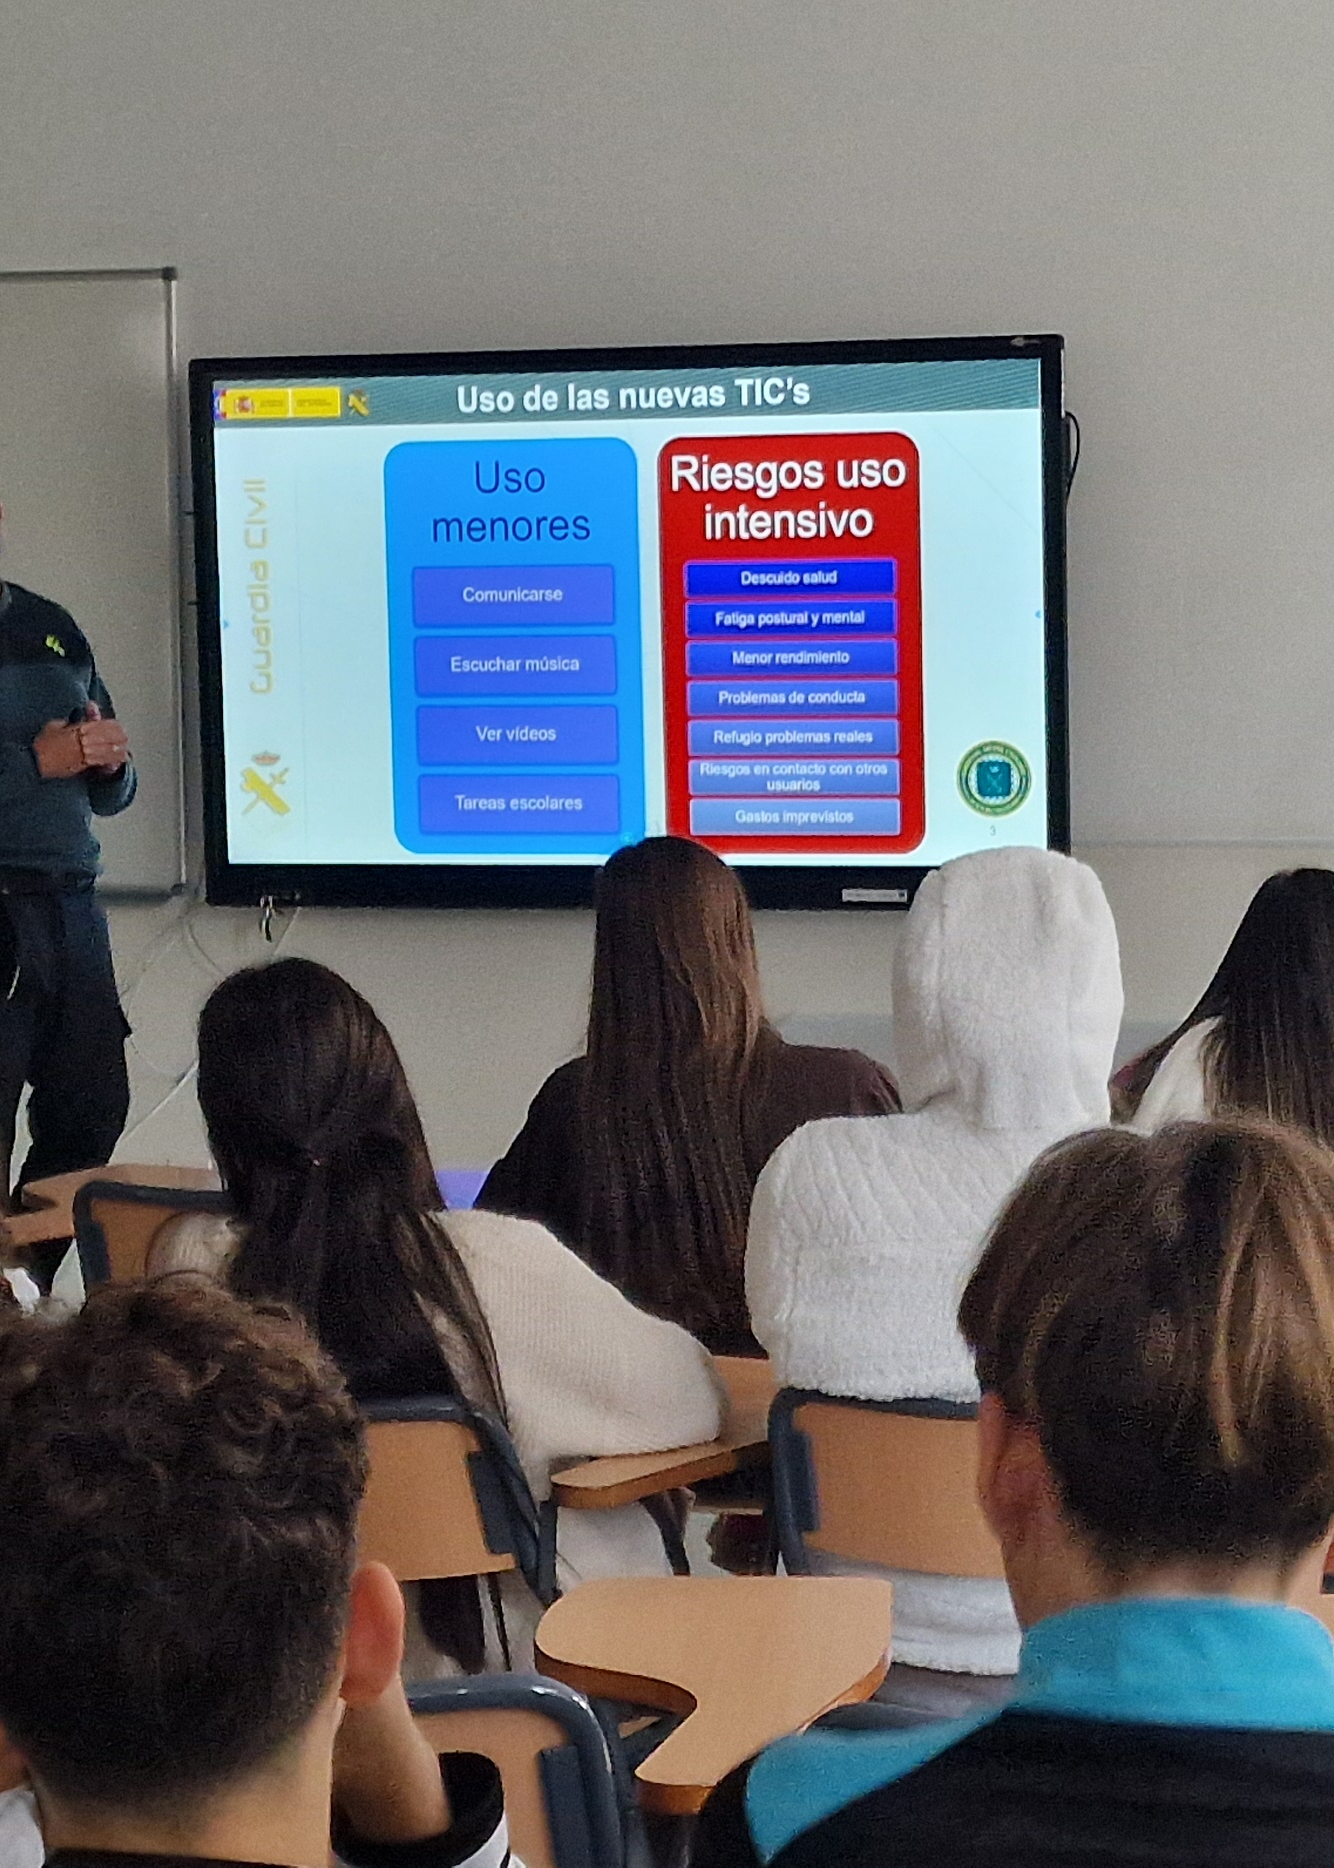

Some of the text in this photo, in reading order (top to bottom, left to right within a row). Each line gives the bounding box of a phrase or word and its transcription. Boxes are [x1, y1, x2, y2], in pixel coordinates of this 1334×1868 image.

[457, 377, 811, 414] Uso de las nuevas TIC's
[475, 460, 546, 494] Uso
[671, 454, 906, 498] Riesgos uso
[432, 514, 591, 543] menores
[704, 501, 874, 540] intensivo
[741, 570, 838, 586] Descuido salud
[463, 586, 563, 603] Comunicarse
[715, 610, 865, 629] Fatiga postural y mental
[450, 654, 580, 672] Escuchar música
[732, 650, 850, 666] Menor rendimiento
[718, 690, 865, 706] Problemas de conducta
[476, 725, 557, 742] Ver vídeos
[714, 730, 873, 746] Refugio problemas reales
[700, 762, 887, 777] Riesgos en contacto con otros
[767, 778, 820, 791] usuarios
[455, 794, 583, 812] Tareas escolares
[735, 809, 854, 825] Gastos imprevistos
[989, 825, 997, 837] 3
